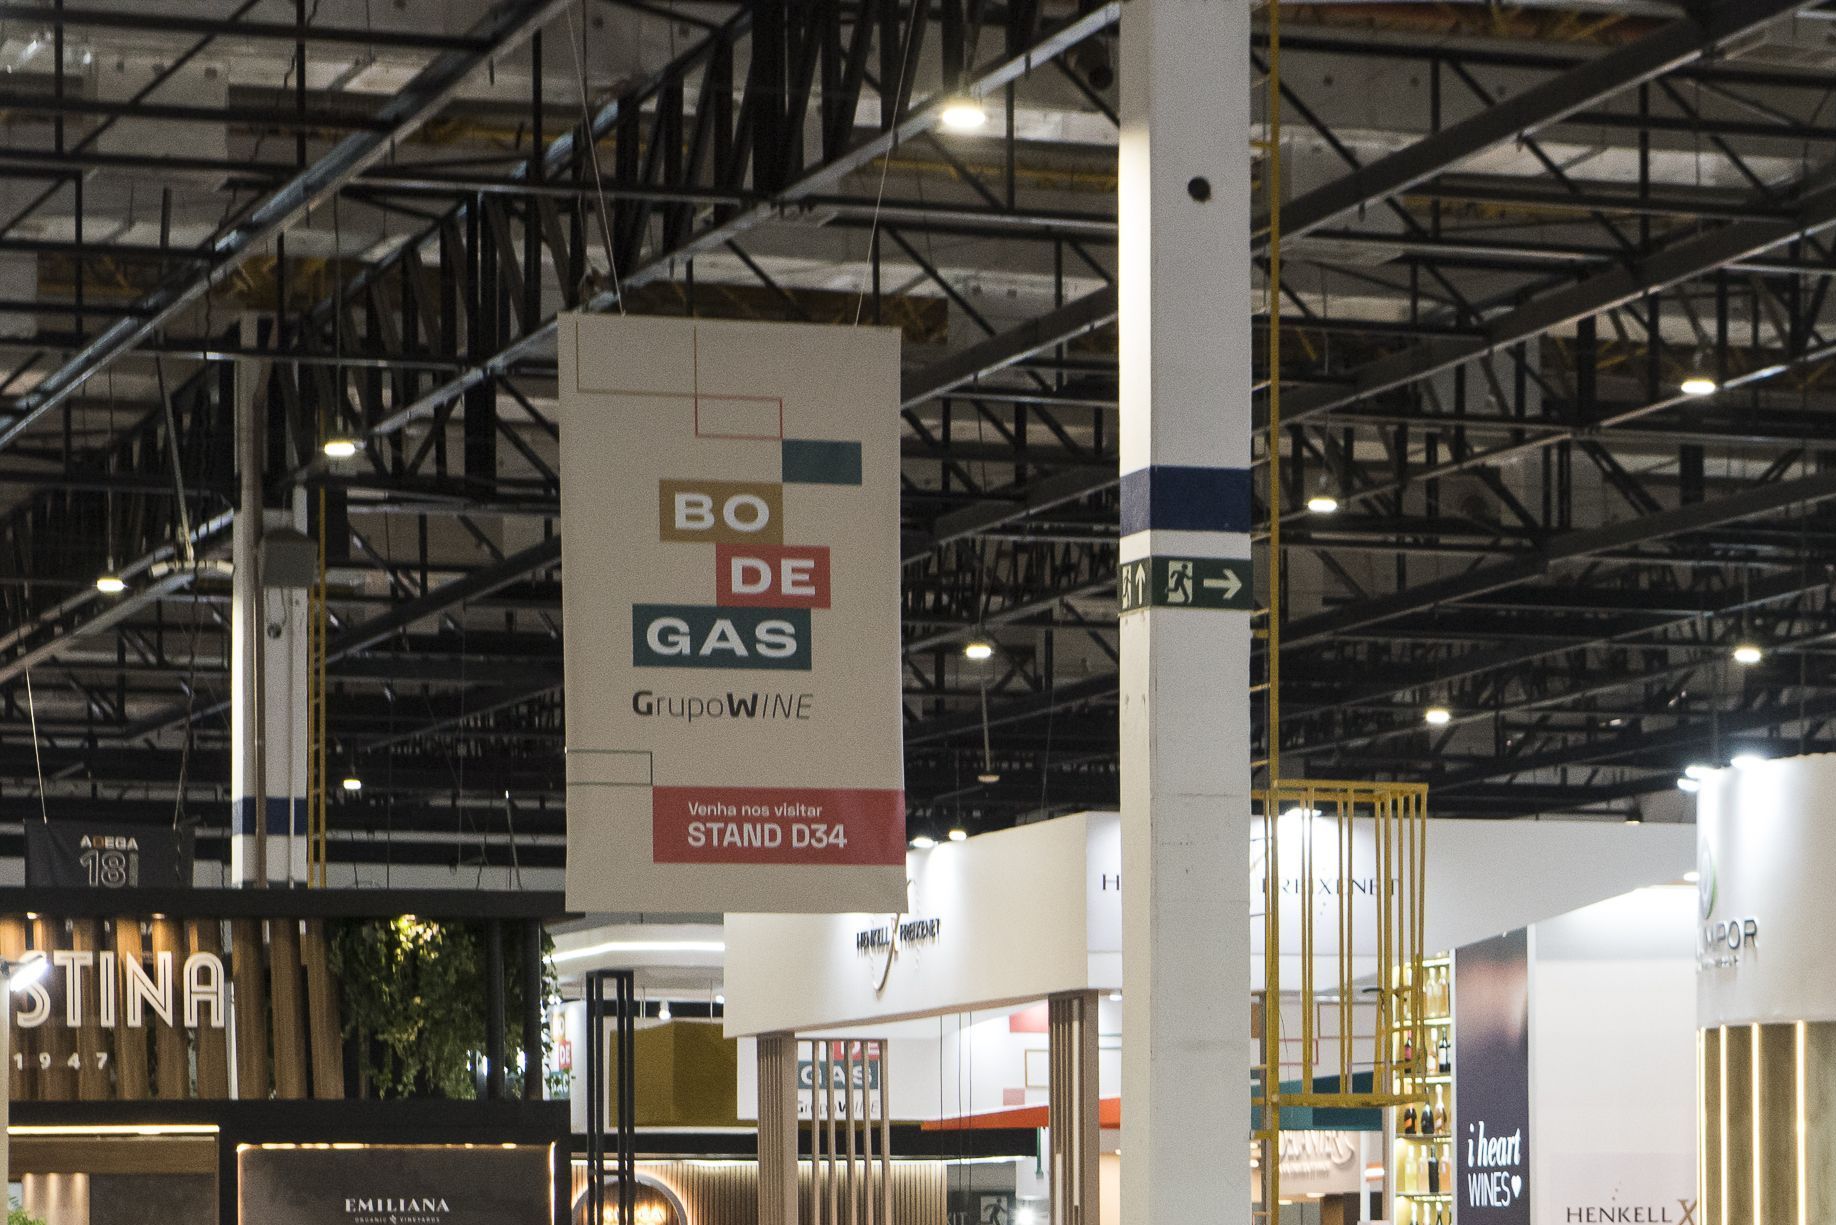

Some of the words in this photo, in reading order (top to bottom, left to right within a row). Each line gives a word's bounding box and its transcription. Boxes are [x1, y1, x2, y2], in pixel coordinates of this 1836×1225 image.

[673, 493, 771, 533] BO
[730, 557, 816, 597] DE
[645, 617, 798, 658] GAS
[632, 690, 814, 723] GrupoWINE
[688, 801, 737, 817] Venha
[741, 804, 769, 817] nos
[774, 802, 823, 818] visitar
[687, 821, 782, 848] STAND
[791, 823, 848, 849] D34
[1478, 1121, 1522, 1167] heart
[344, 1198, 450, 1213] EMILIANA
[1467, 1171, 1512, 1208] WINES
[1566, 1206, 1672, 1224] HENKELL
